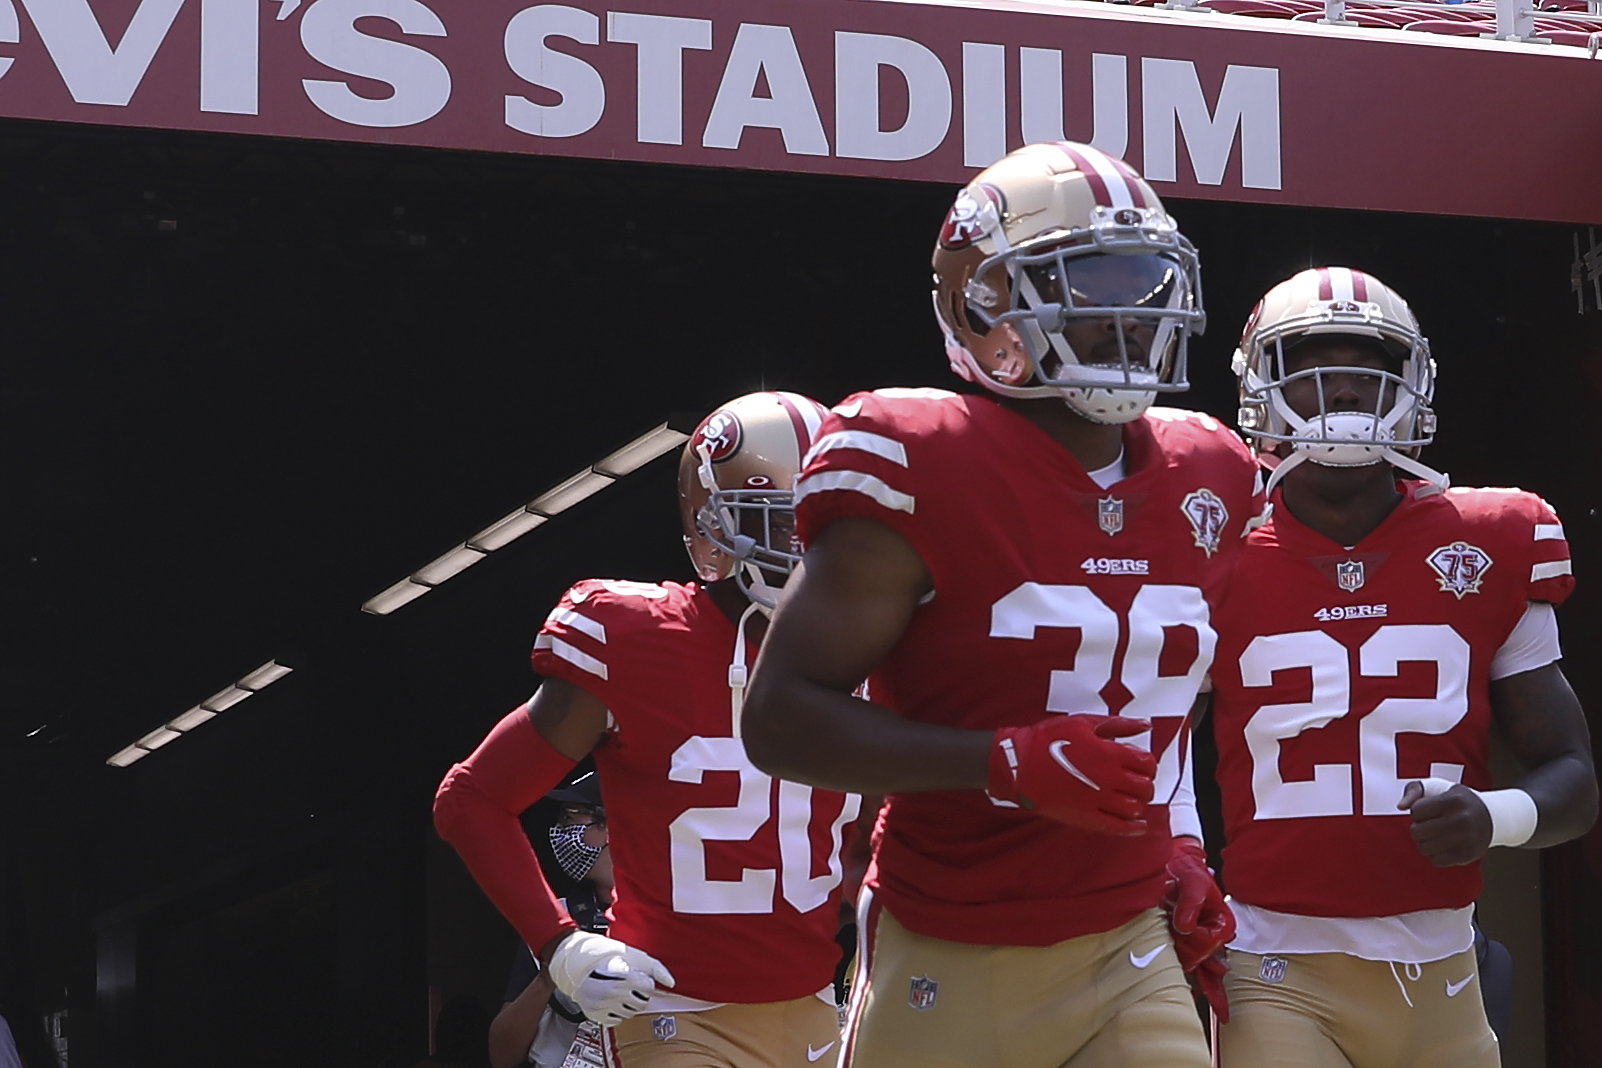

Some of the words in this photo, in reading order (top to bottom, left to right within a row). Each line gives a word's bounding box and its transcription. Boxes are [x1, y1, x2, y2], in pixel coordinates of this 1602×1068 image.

[503, 4, 1283, 190] STADIUM
[1101, 513, 1120, 528] NFL
[1080, 558, 1149, 575] 49ERS
[1443, 554, 1478, 581] 75
[1341, 574, 1361, 588] NFL
[1313, 604, 1388, 621] 49ERS
[1239, 624, 1470, 820] 22
[668, 735, 863, 914] 20
